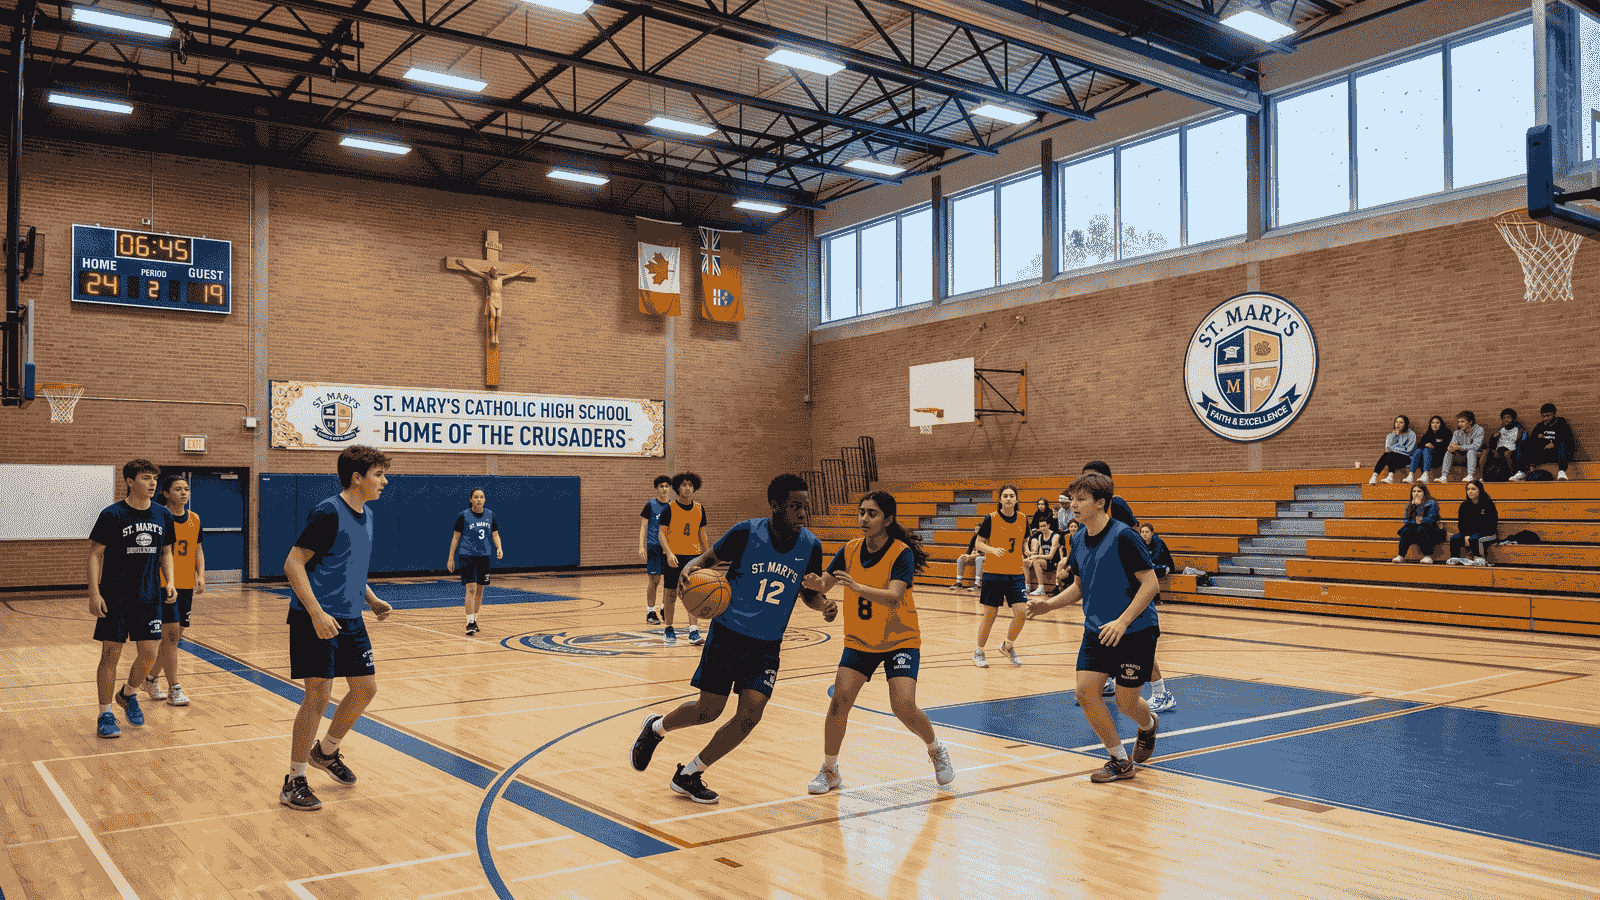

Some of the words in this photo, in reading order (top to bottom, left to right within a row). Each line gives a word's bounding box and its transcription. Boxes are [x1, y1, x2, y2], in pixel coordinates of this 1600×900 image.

[120, 234, 188, 260] 06:45
[82, 258, 117, 271] HOME
[141, 268, 167, 278] PERIOD
[188, 267, 224, 281] GUEST
[87, 272, 117, 295] 24
[149, 280, 159, 298] 2
[204, 284, 223, 305] 19
[1198, 320, 1224, 348] ST.
[1225, 304, 1300, 337] MARY'S
[1226, 378, 1241, 394] M
[326, 392, 361, 409] MARY'S
[373, 394, 396, 411] ST.
[401, 396, 461, 415] MARY'S
[465, 399, 536, 417] CATHOLIC
[541, 402, 574, 419] HIGH
[578, 404, 632, 422] SCHOOL
[1210, 409, 1231, 424] FAITH
[1239, 405, 1288, 426] EXCELLENCE
[384, 421, 442, 444] HOME
[449, 423, 473, 445] OF
[478, 424, 514, 446] THE
[519, 425, 626, 448] CRUSADERS
[478, 529, 485, 540] 3
[178, 540, 188, 556] 3
[767, 561, 799, 583] MARY'S
[755, 578, 785, 606] 12
[858, 596, 872, 620] 8
